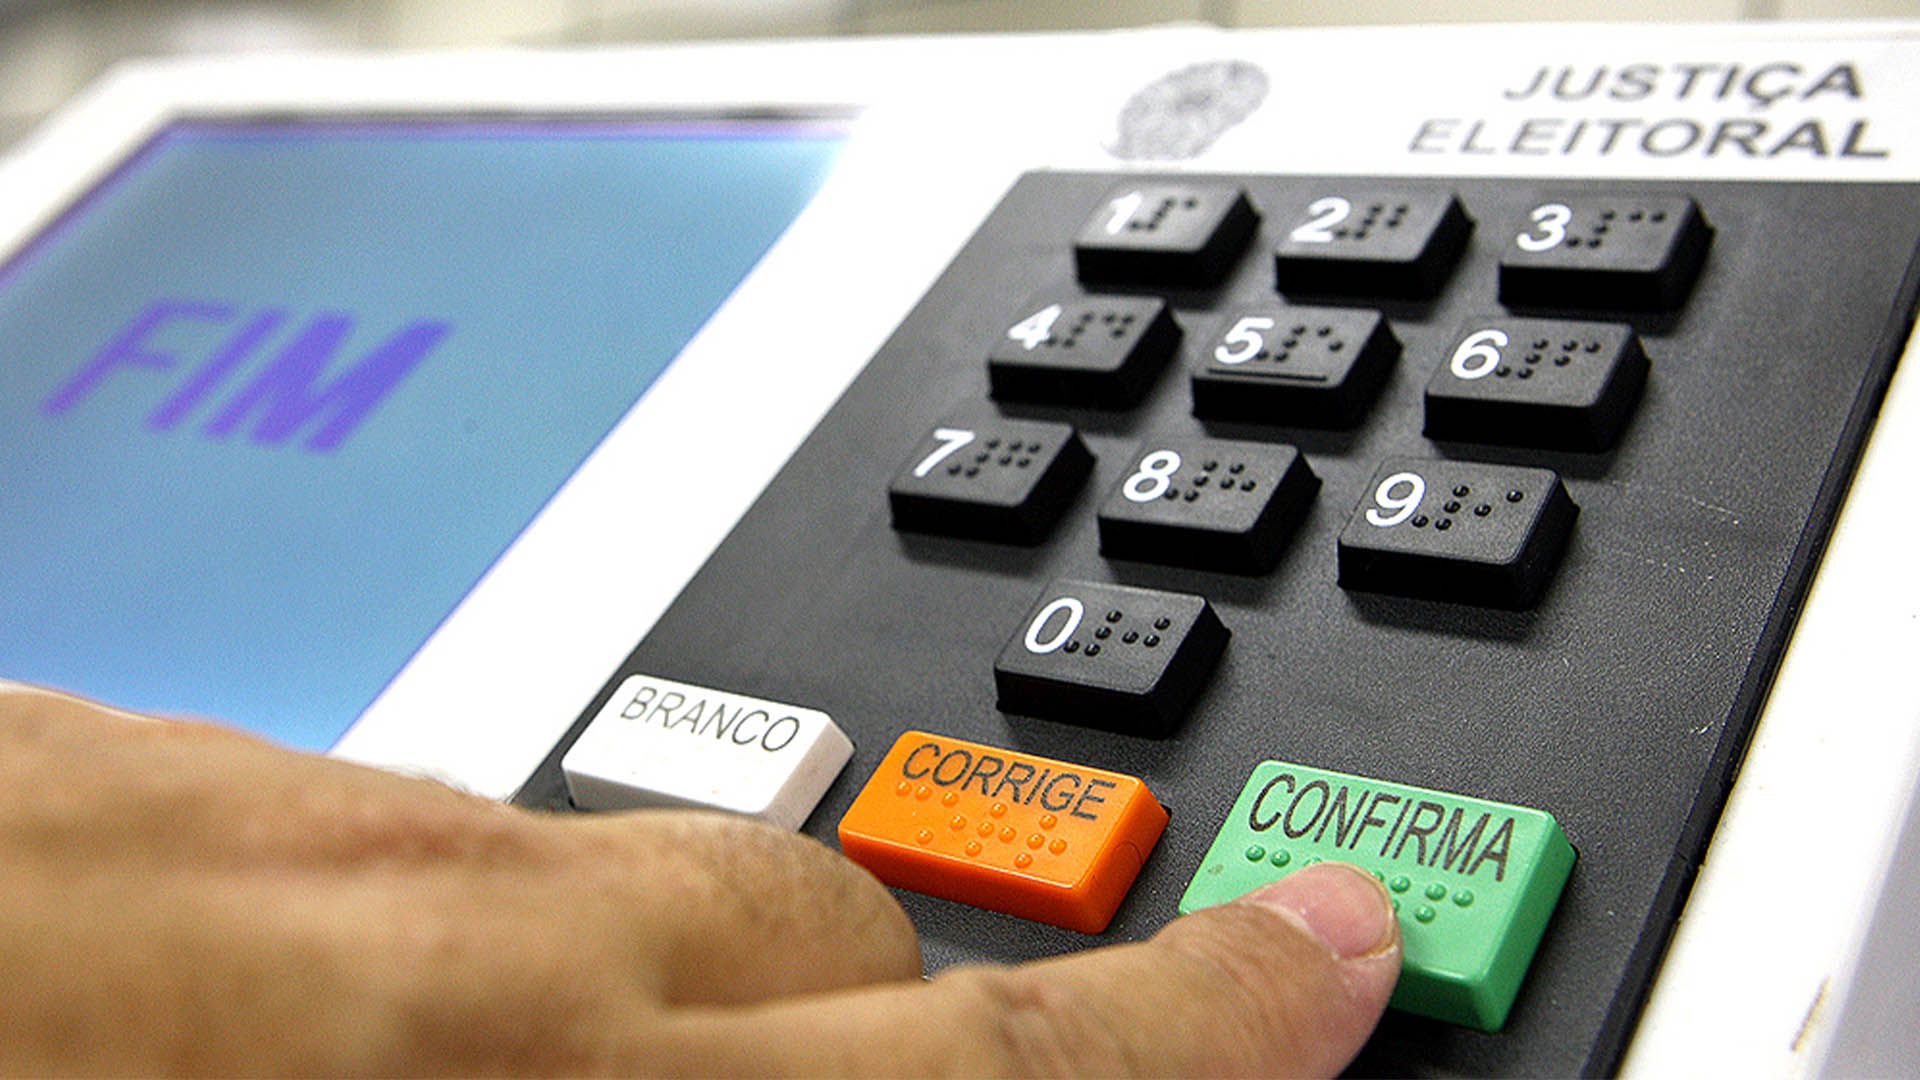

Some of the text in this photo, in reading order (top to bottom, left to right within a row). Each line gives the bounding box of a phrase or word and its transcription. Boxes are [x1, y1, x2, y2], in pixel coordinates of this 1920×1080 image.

[1504, 62, 1864, 111] JUSTIÇA
[1407, 118, 1891, 159] ELEITORAL
[1106, 193, 1143, 234] 1
[1291, 198, 1351, 242] 2
[1518, 205, 1572, 251] 3
[1009, 304, 1061, 349] 4
[1214, 317, 1274, 364] 5
[41, 299, 453, 454] FIM
[1451, 330, 1508, 379] 6
[913, 429, 975, 477] 7
[1122, 451, 1181, 501] 8
[1366, 472, 1426, 527] 9
[1024, 598, 1084, 654] 0
[620, 686, 800, 752] BRANCO
[902, 743, 1117, 820] CORRIGE
[1249, 774, 1516, 882] CONFIRMA
